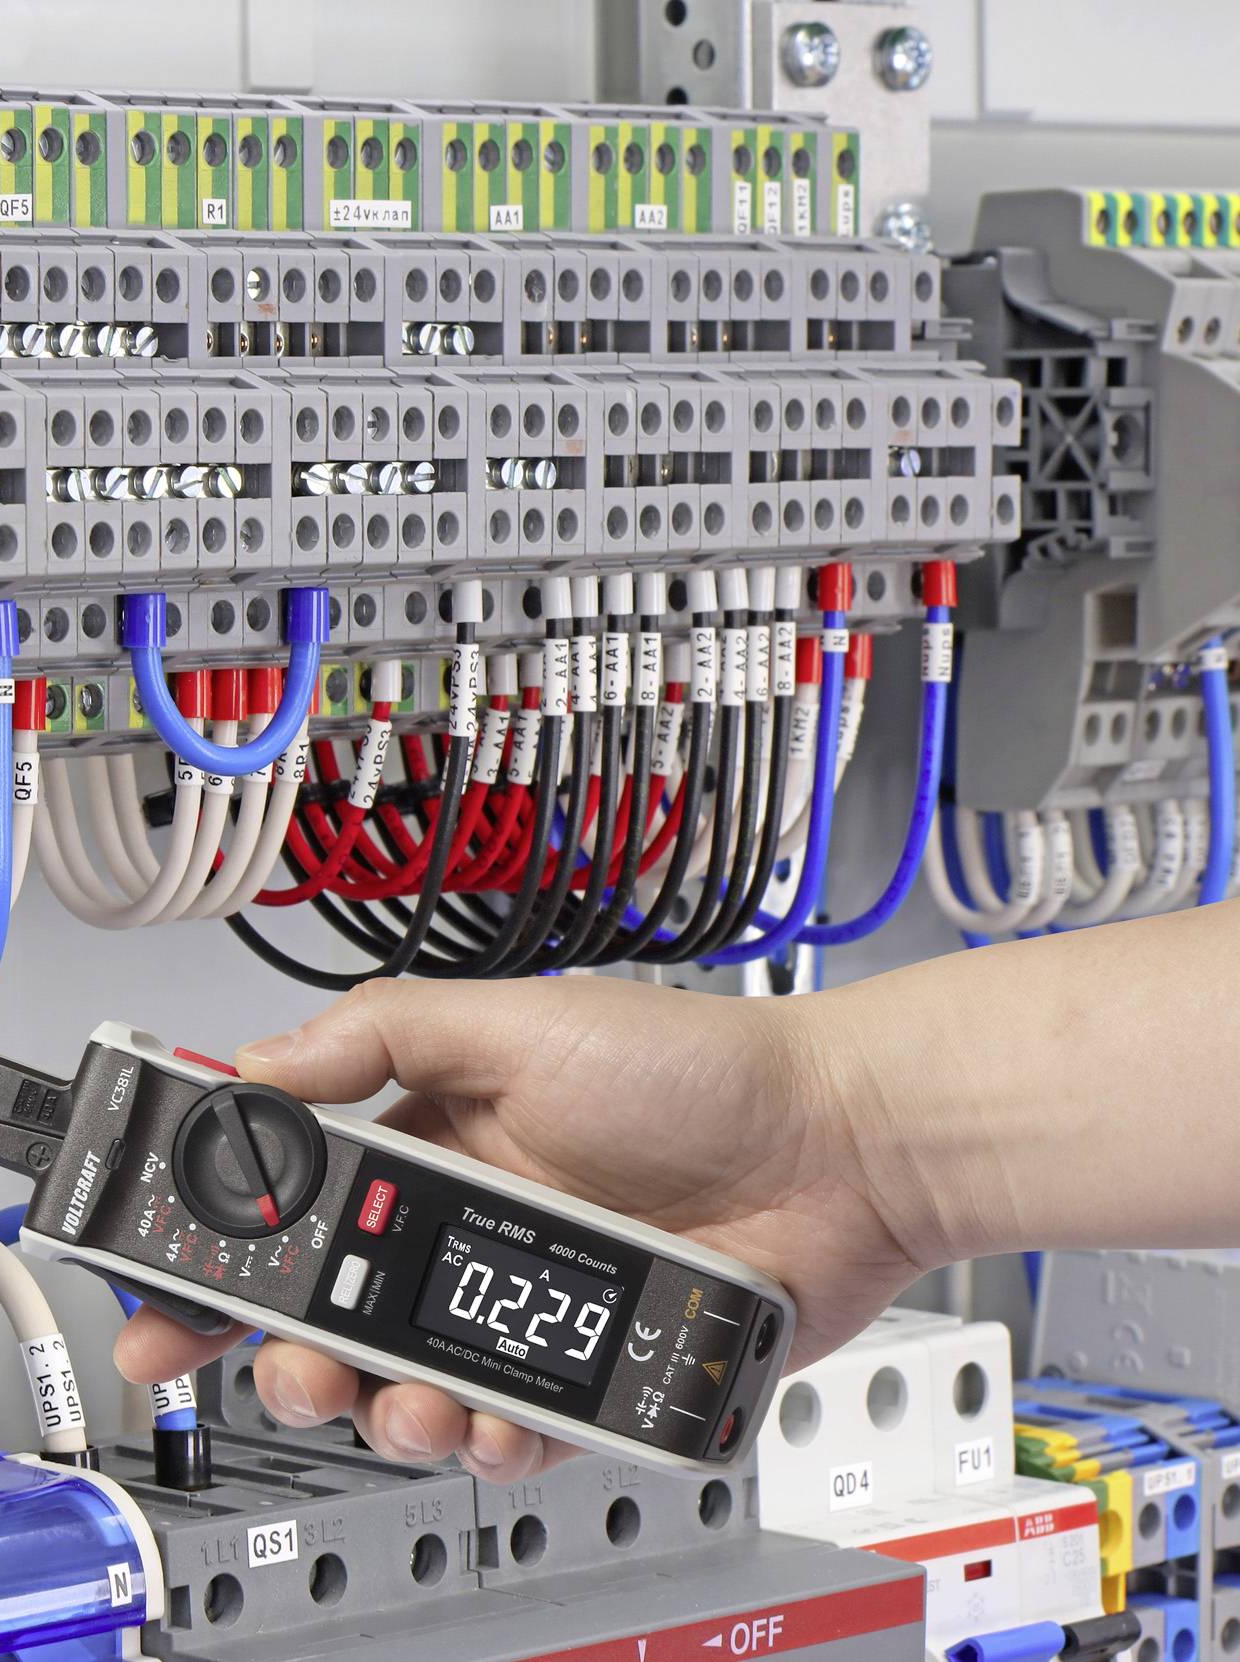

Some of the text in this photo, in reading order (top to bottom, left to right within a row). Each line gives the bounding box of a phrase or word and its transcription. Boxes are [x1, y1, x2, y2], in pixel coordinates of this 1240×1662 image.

[0, 197, 30, 217] QF5
[207, 203, 223, 220] R1
[494, 209, 521, 227] AA1
[638, 207, 665, 225] AA2
[603, 635, 619, 701] 6-AA1
[641, 637, 657, 701] 8-AA1
[696, 632, 713, 698] 2-AA2
[777, 626, 793, 691] 8-AA2
[14, 761, 33, 801] QF5
[107, 1066, 135, 1112] VC381L
[140, 1152, 160, 1183] NCV
[61, 1150, 102, 1236] VOLTCRAFT
[366, 1184, 389, 1229] SELECT
[311, 1219, 329, 1250] OFF
[461, 1206, 537, 1245] True RMS
[441, 1251, 464, 1268] AC
[539, 1268, 551, 1283] A
[548, 1242, 618, 1276] 4000 Counts
[448, 1260, 611, 1362] 0.229
[685, 1287, 704, 1320] COM
[425, 1335, 565, 1394] 40A AC/DC Mini Clamp Meter
[497, 1338, 527, 1359] Auto
[662, 1365, 676, 1385] CAT
[675, 1324, 689, 1351] 600V
[957, 1444, 992, 1474] FU1
[833, 1469, 870, 1498] QD4
[1023, 1512, 1055, 1538] ABB
[253, 1528, 295, 1560] QS1
[115, 1571, 128, 1599] N
[729, 1614, 785, 1656] OFF
